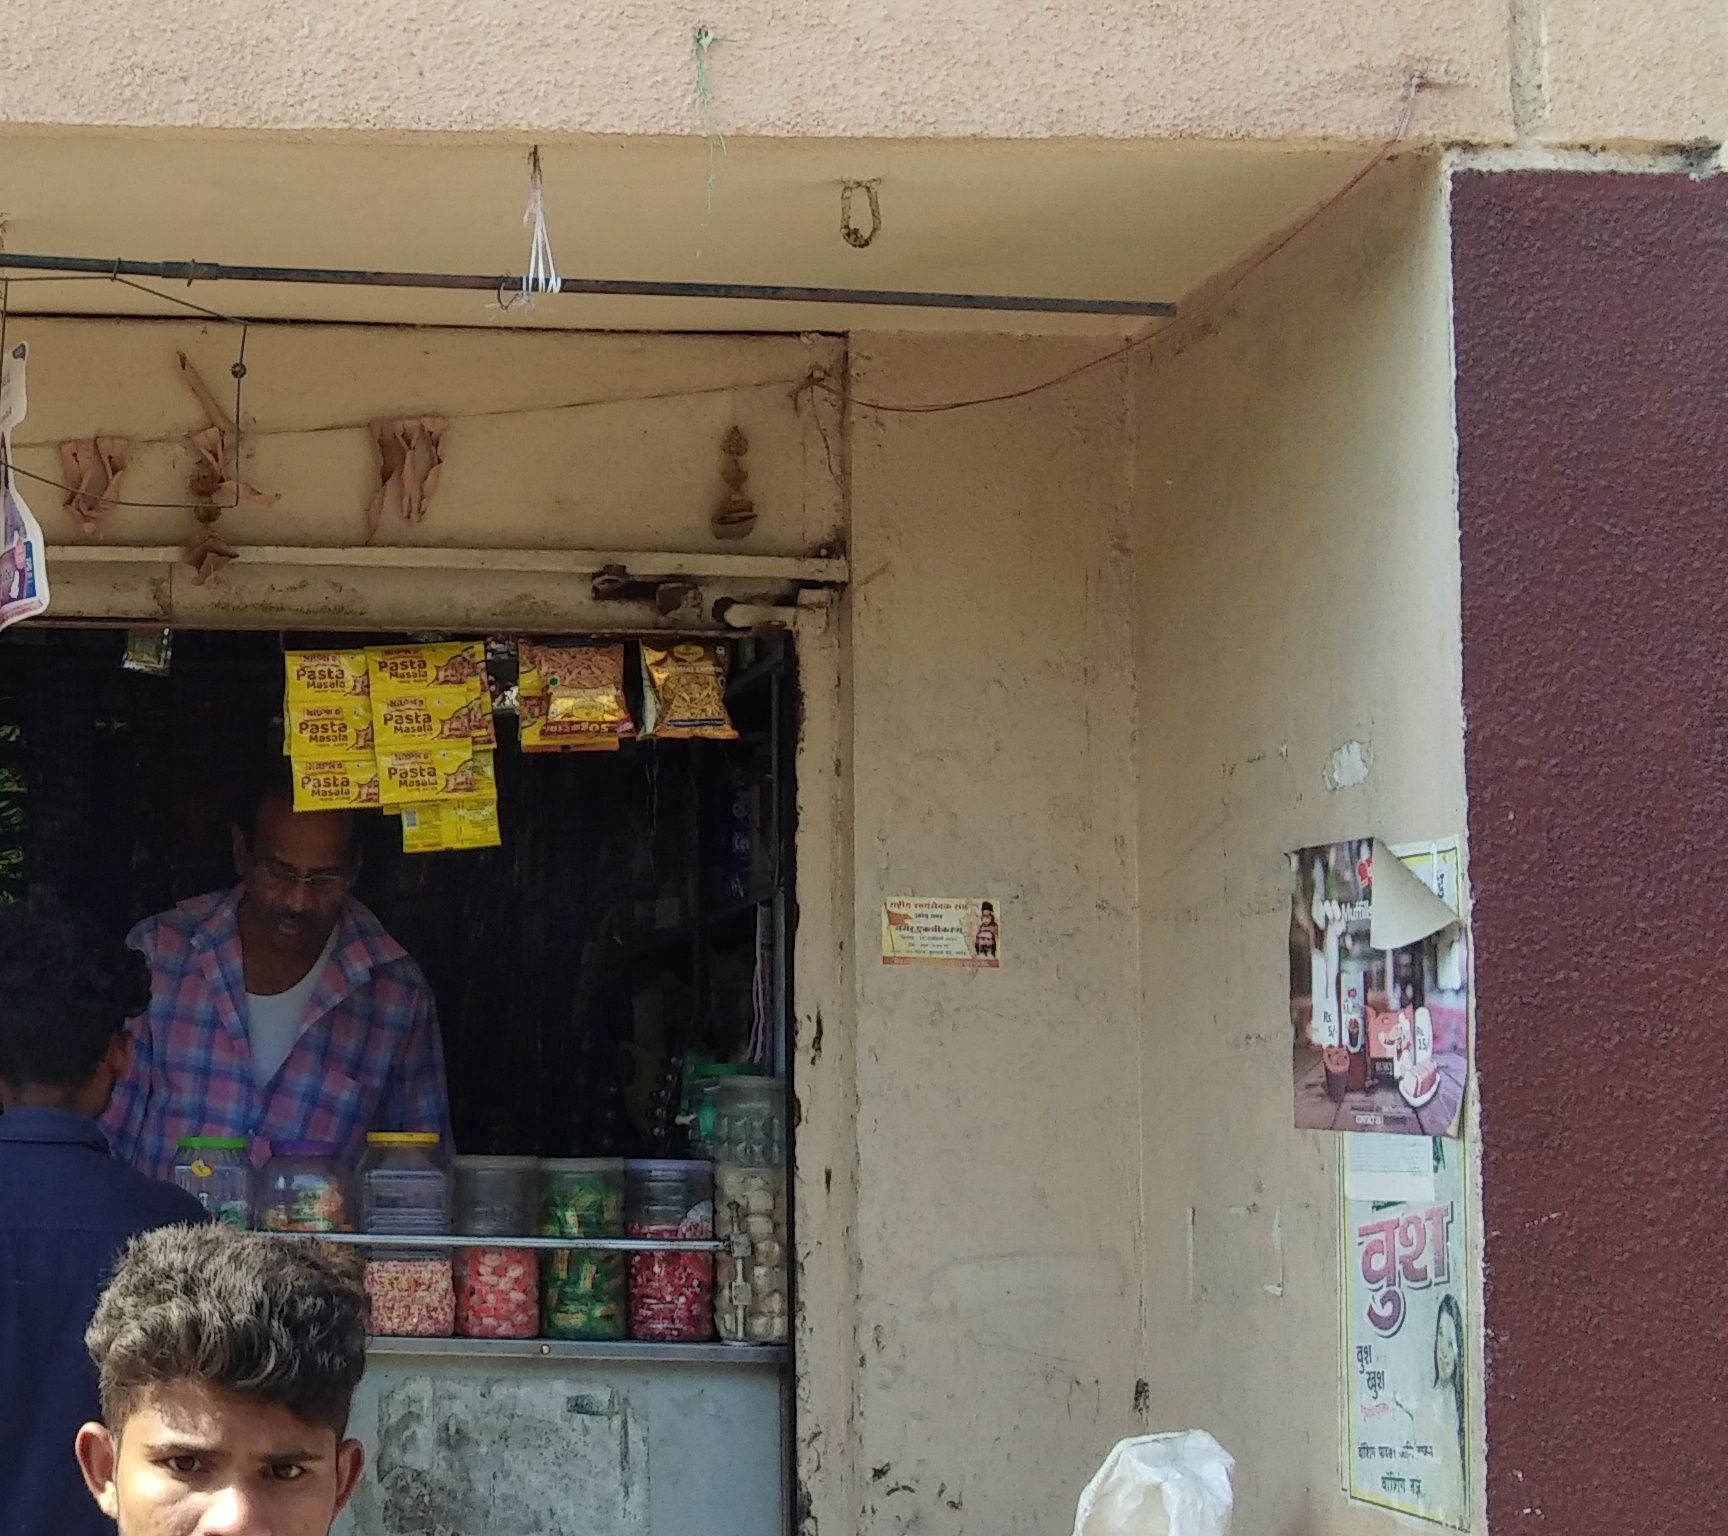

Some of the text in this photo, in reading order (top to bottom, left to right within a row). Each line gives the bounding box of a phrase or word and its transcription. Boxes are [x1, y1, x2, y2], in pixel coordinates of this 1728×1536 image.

[378, 658, 427, 672] Pasta
[296, 667, 345, 681] Pasta
[383, 712, 432, 725] Pasta
[299, 721, 348, 734] Pasta
[388, 766, 437, 780] Pasta
[301, 775, 350, 788] Pasta
